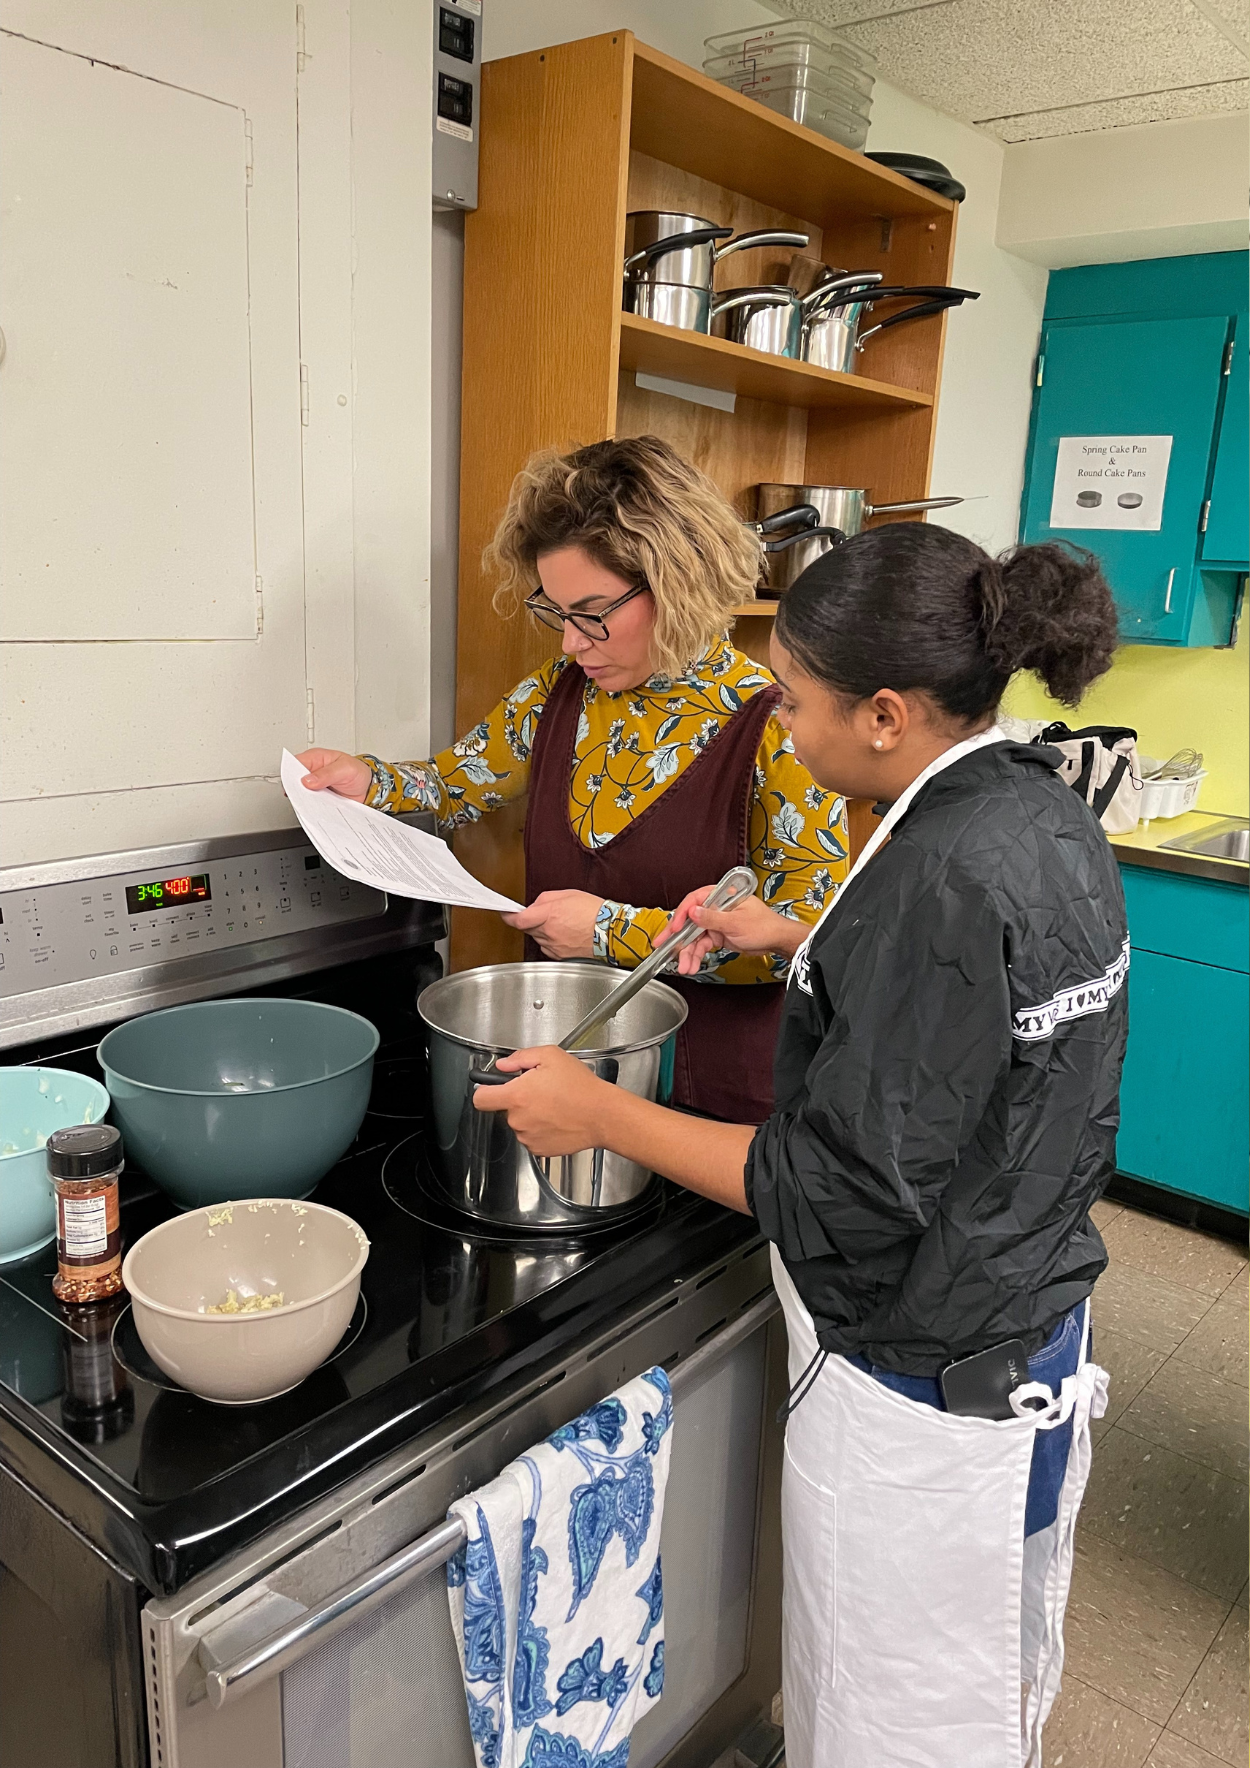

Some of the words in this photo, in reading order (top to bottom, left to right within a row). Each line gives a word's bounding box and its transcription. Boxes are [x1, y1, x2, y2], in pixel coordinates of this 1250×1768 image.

[1082, 445, 1107, 455] Spring
[1109, 444, 1131, 454] Cake
[1132, 444, 1147, 454] Pan
[1108, 456, 1116, 466] &
[1077, 468, 1103, 478] Round
[1104, 468, 1126, 478] Cake
[1127, 468, 1147, 478] Pans
[137, 882, 164, 901] 3:46
[1012, 1014, 1046, 1033] MY
[1065, 996, 1074, 1013] I
[1087, 987, 1110, 1005] MY
